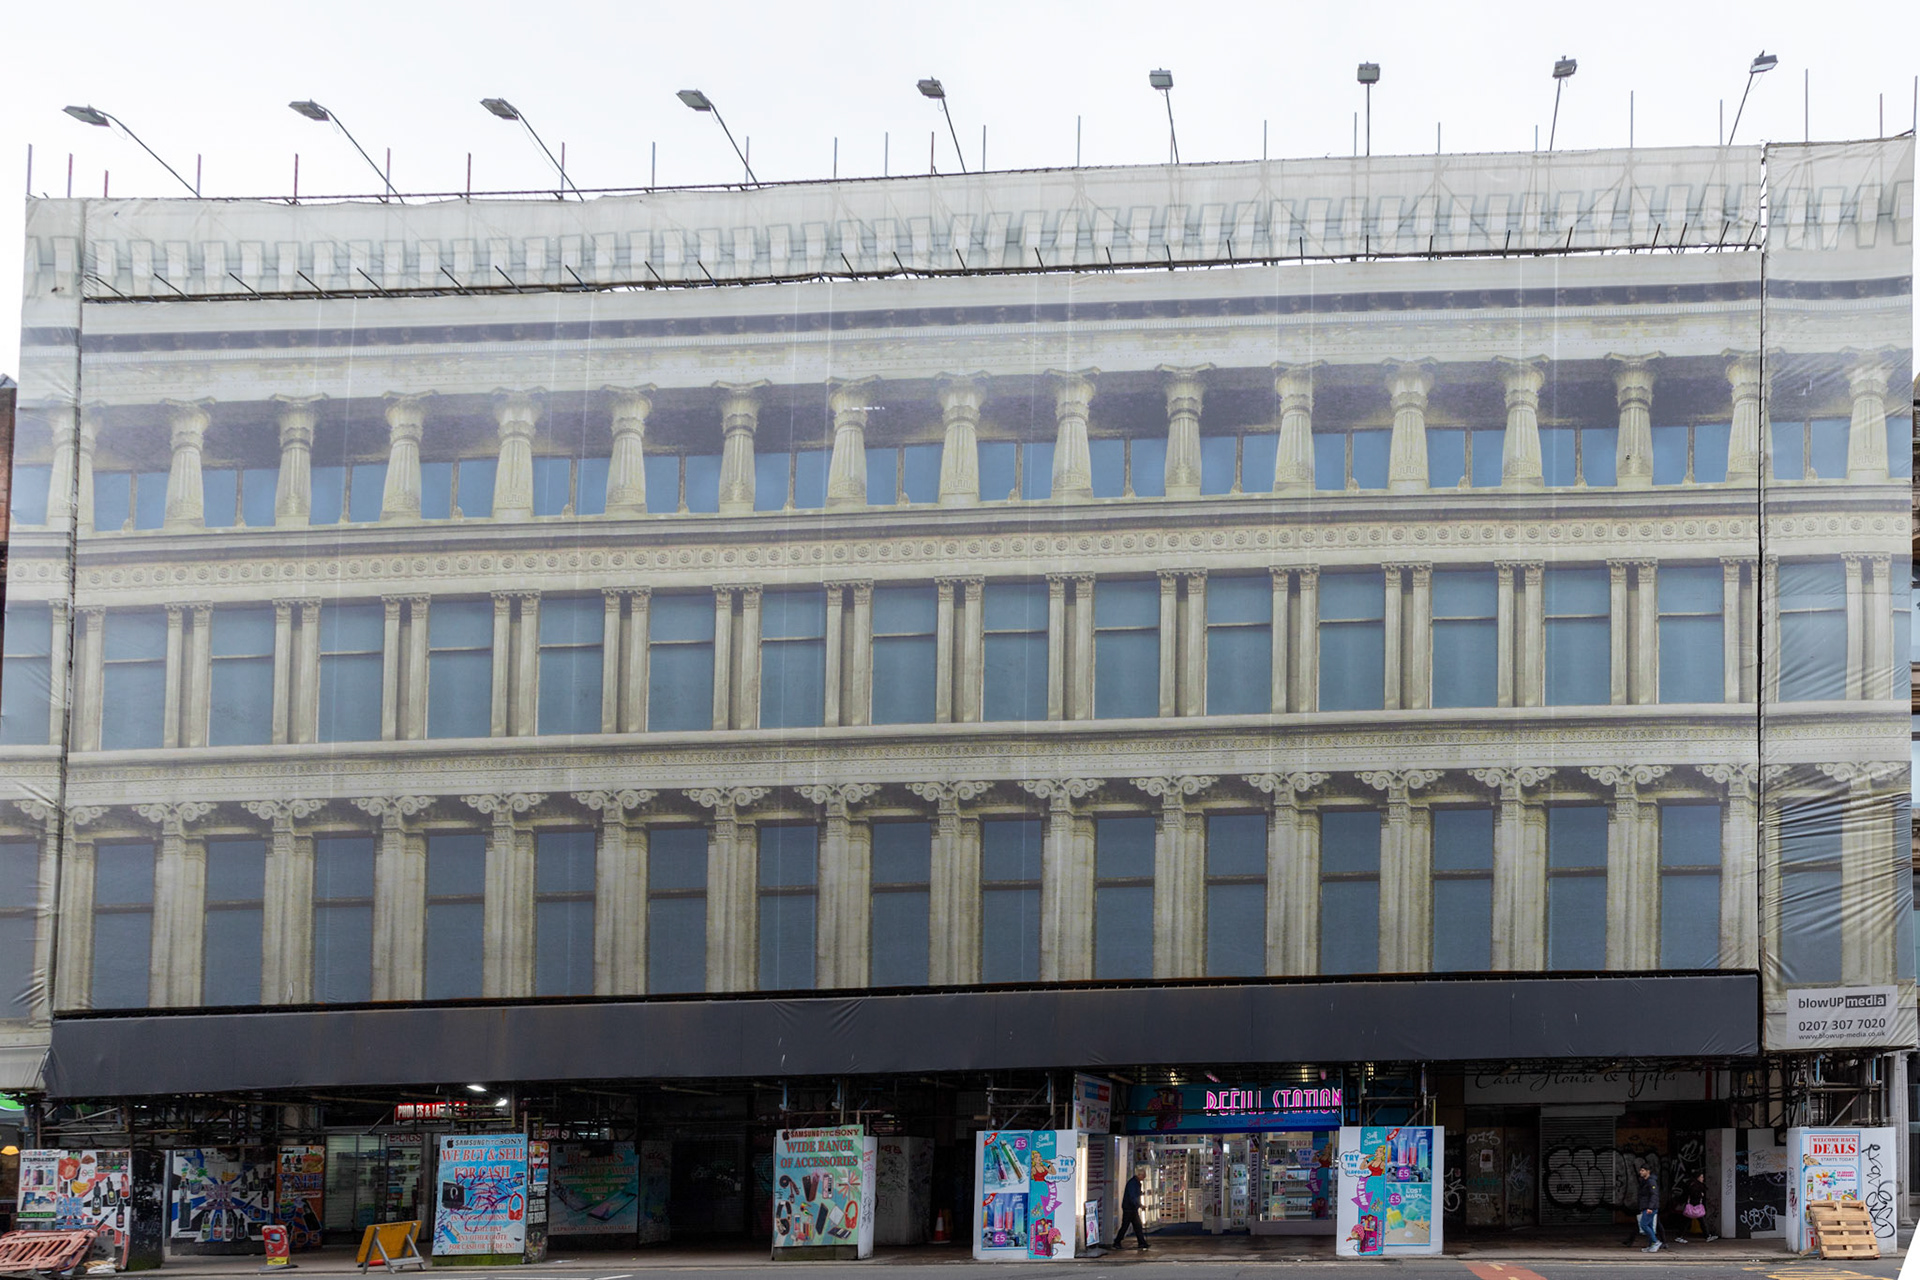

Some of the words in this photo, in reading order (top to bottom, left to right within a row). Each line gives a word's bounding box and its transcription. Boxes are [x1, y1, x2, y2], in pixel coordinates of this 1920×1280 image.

[1798, 1020, 1828, 1031] 0207
[1831, 1019, 1853, 1030] 307
[1857, 1017, 1886, 1029] 7020
[1798, 1030, 1886, 1040] www.blowup-media.co.uk
[1475, 1069, 1523, 1089] Card
[1530, 1069, 1595, 1091] House
[1604, 1069, 1618, 1082] &
[1628, 1069, 1676, 1098] Gifts
[1203, 1090, 1265, 1116] REFILL
[1272, 1088, 1341, 1115] STATION
[426, 1104, 432, 1119] &
[389, 1133, 422, 1143] E-CIGS
[790, 1131, 819, 1139] SAMSUNG
[834, 1129, 860, 1137] SONY
[785, 1141, 816, 1154] WIDE
[818, 1140, 854, 1152] RANGE
[1015, 1139, 1027, 1148] £5
[1813, 1143, 1856, 1155] DEALS
[442, 1149, 461, 1161] WE
[462, 1149, 487, 1161] BUY
[487, 1149, 497, 1160] &
[498, 1148, 526, 1160] SELL
[780, 1158, 793, 1168] OF
[795, 1156, 858, 1168] ACCESSORIES
[454, 1167, 476, 1179] FOR
[478, 1166, 511, 1179] CASH
[1398, 1169, 1409, 1178] £5
[1389, 1195, 1401, 1203] £5
[994, 1234, 1006, 1242] £5
